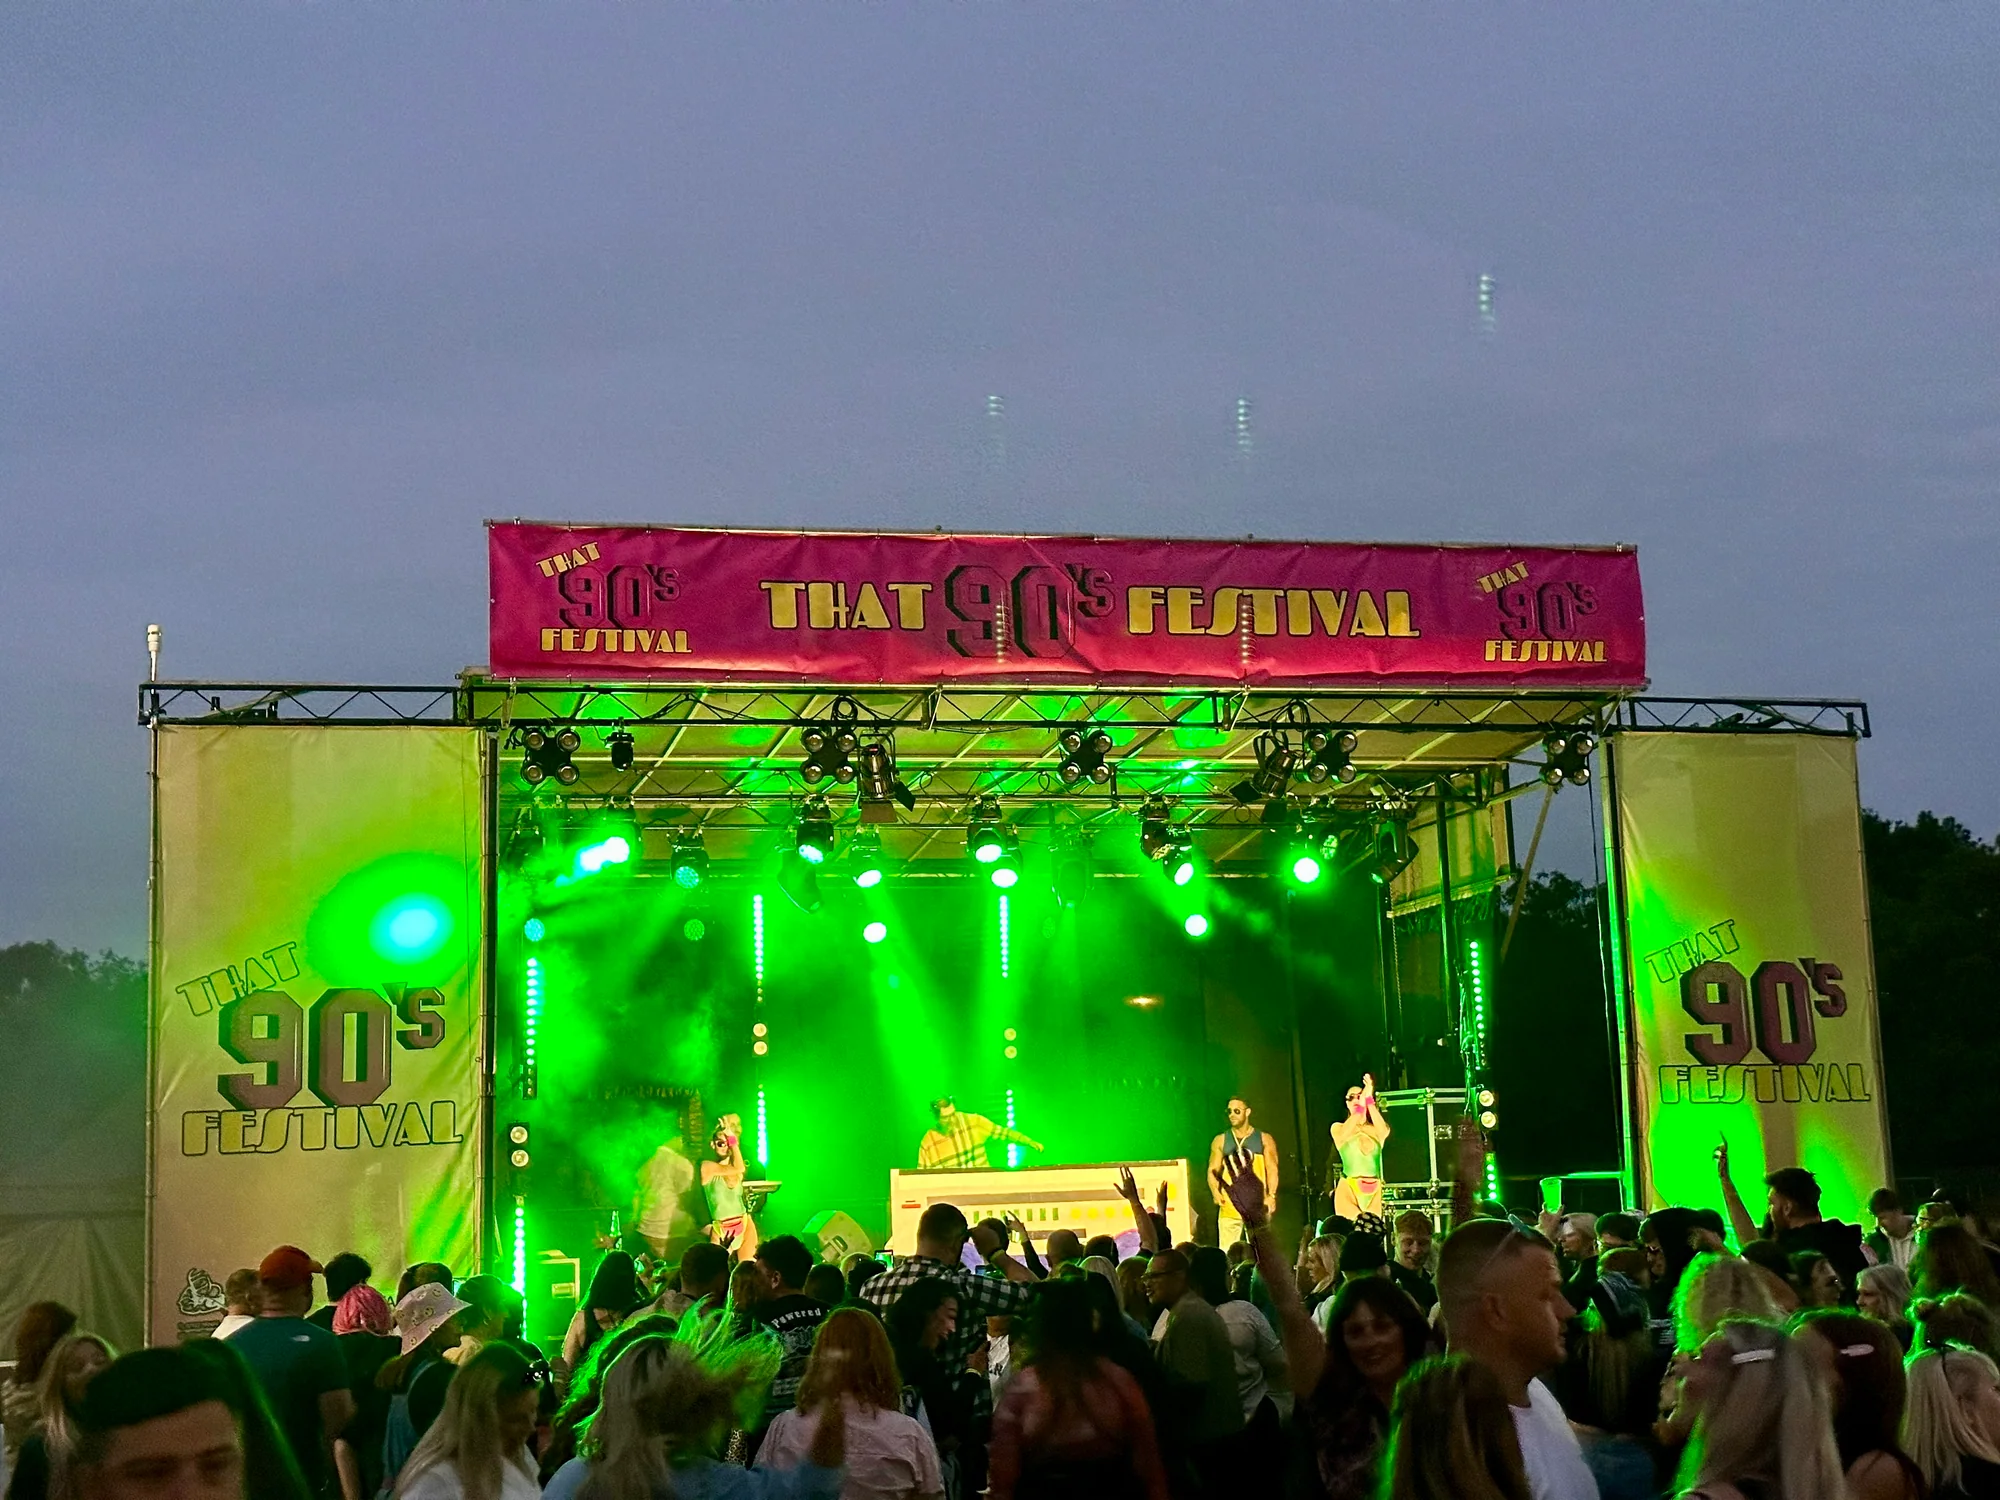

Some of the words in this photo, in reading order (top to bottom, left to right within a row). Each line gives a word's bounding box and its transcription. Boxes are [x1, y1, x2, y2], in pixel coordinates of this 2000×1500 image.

[536, 541, 601, 578] THAT
[1476, 560, 1529, 594] THAT
[760, 580, 932, 631] THAT
[1127, 585, 1421, 638] FESTIVAL
[540, 628, 692, 654] FESTIVAL
[1484, 638, 1607, 663] FESTIVAL
[1644, 919, 1740, 983] THAT
[176, 941, 300, 1016] THAT
[1658, 1063, 1871, 1104] FESTIVAL
[182, 1100, 463, 1156] FESTIVAL
[771, 1308, 821, 1328] Powered
